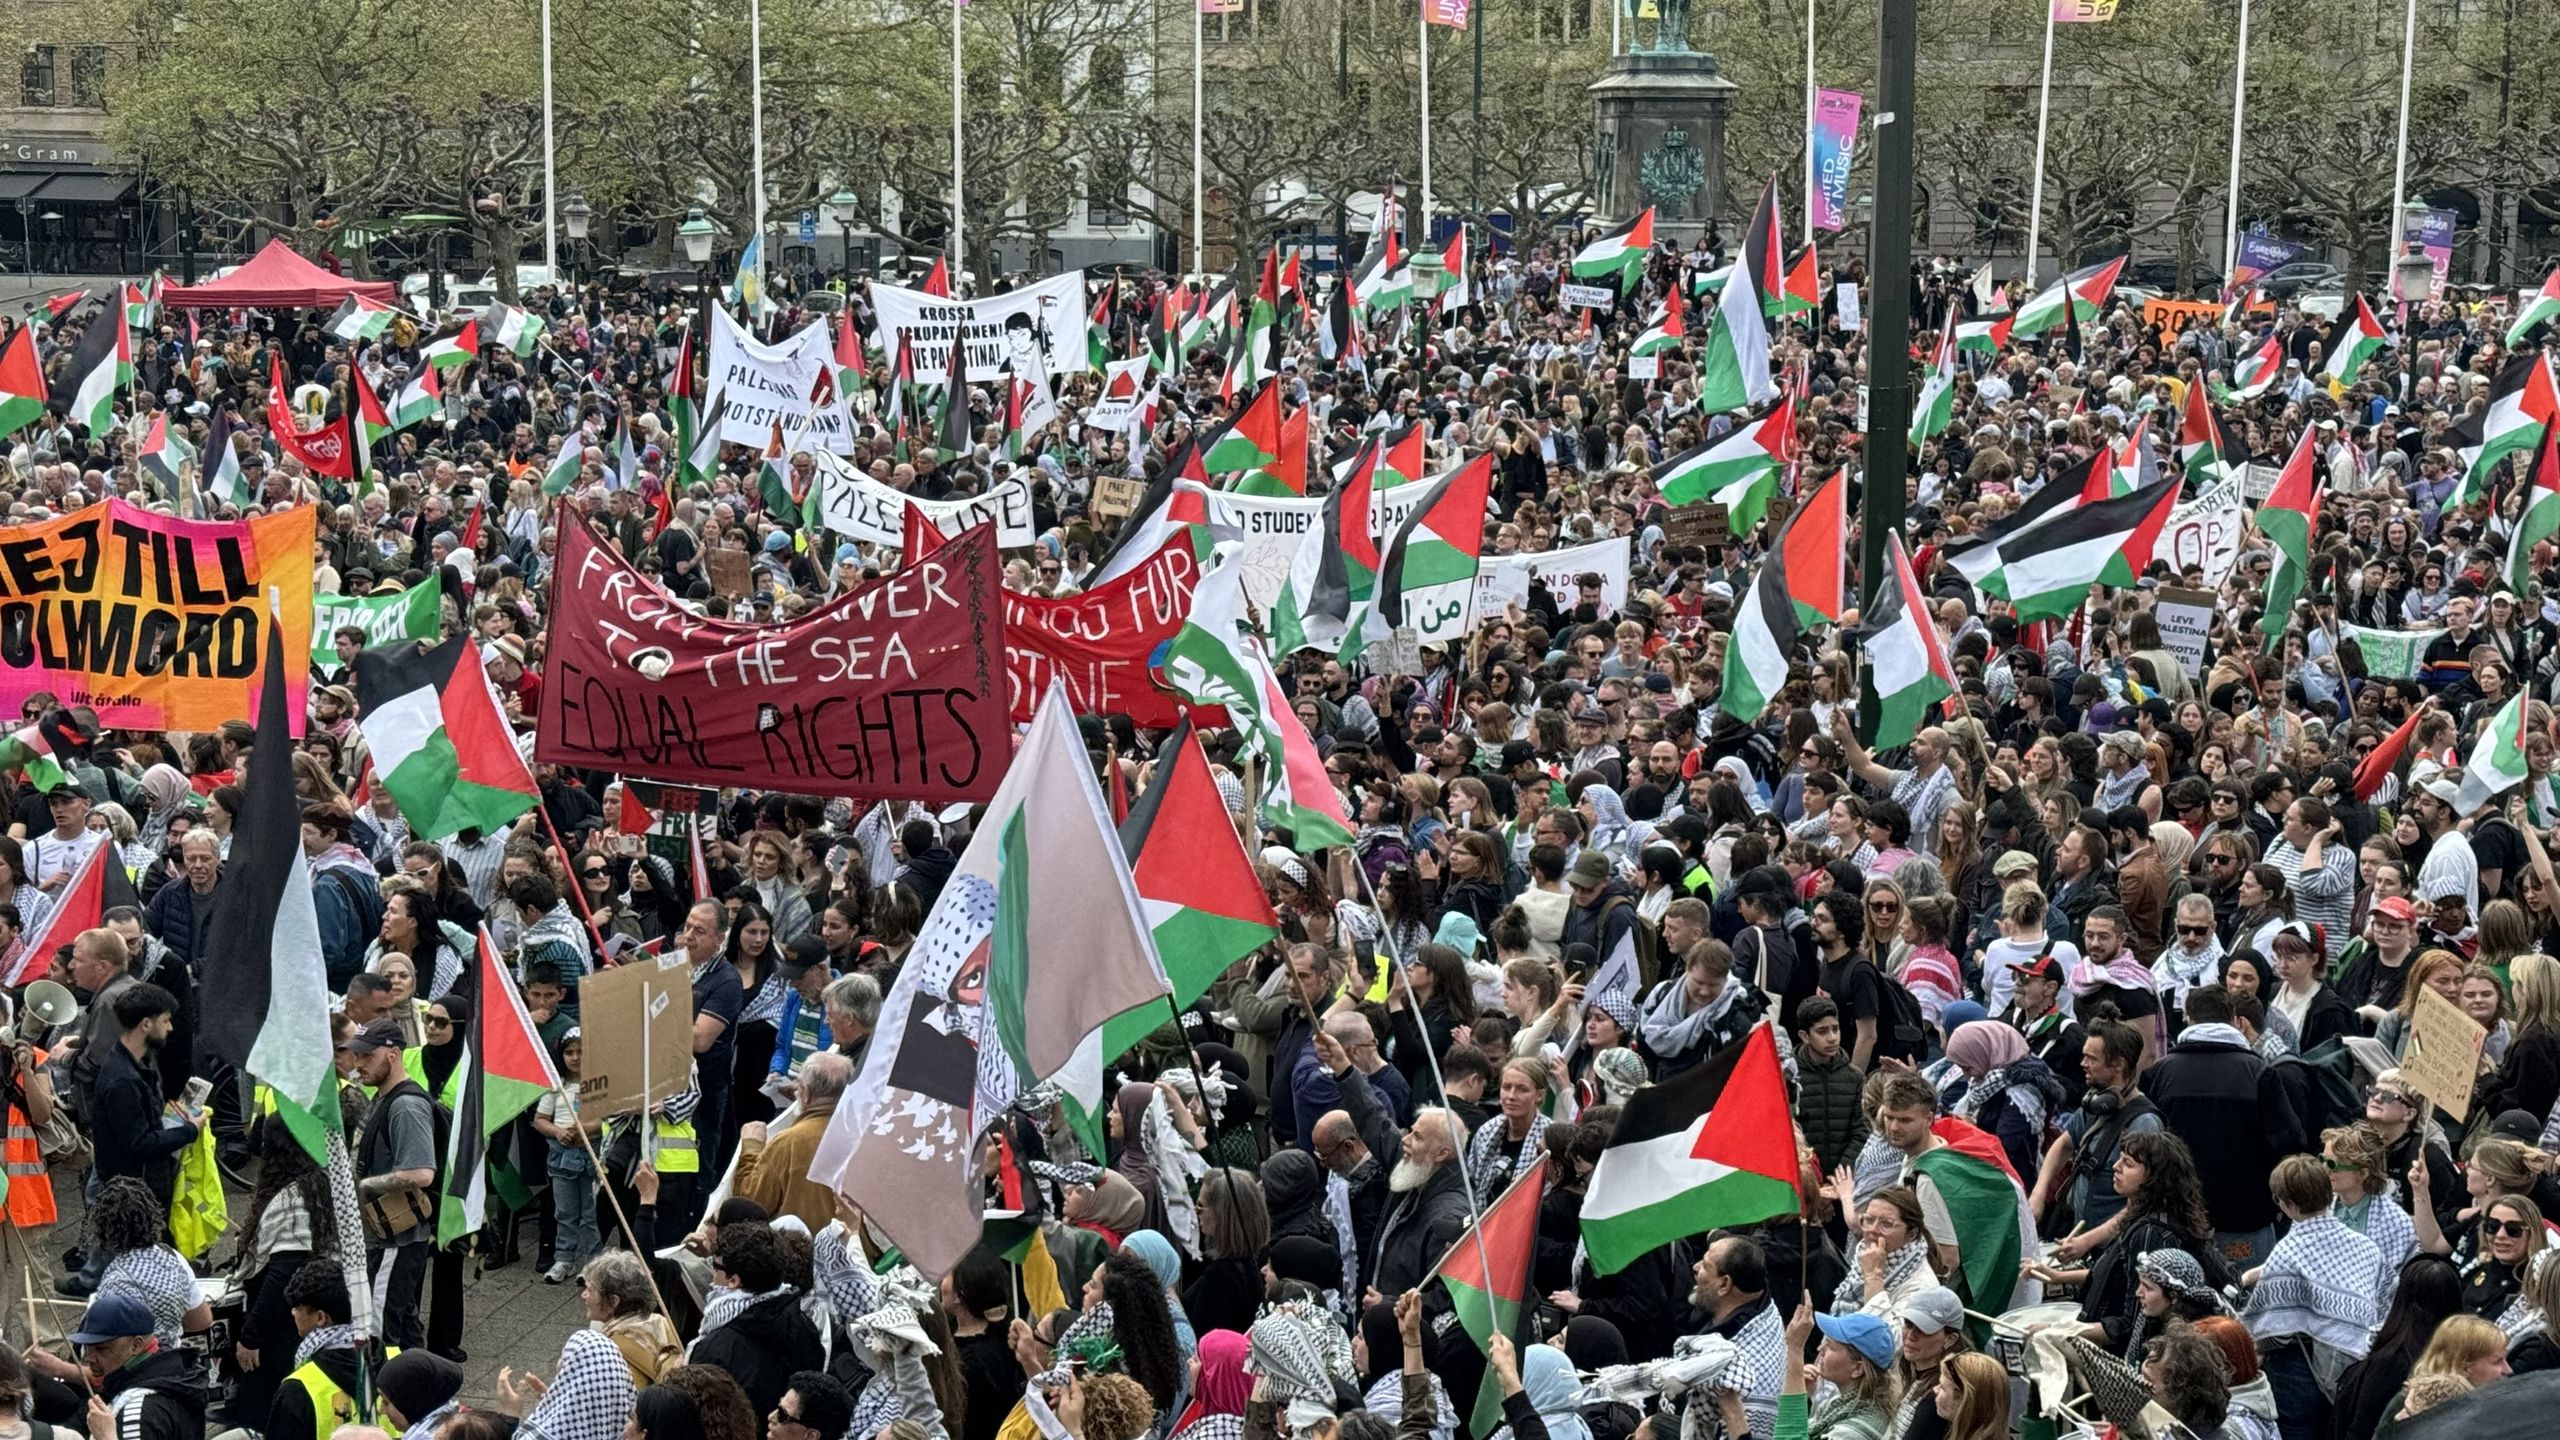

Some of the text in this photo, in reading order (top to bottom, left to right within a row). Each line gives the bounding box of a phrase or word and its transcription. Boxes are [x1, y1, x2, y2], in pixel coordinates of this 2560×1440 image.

[18, 145, 78, 160] Gram
[1832, 135, 1853, 198] MUSIC
[803, 212, 811, 225] P
[2430, 256, 2448, 308] USIC
[919, 306, 976, 321] KROSSA
[897, 323, 1003, 341] OCKUPATONEN!
[721, 400, 841, 434] MOTSTÅNDKAMP
[820, 468, 1029, 535] PALETINE
[113, 518, 260, 605] TILL
[1561, 569, 1610, 587] DÖA
[1421, 599, 1461, 634] من
[2171, 614, 2195, 626] LEVE
[599, 620, 673, 682] TO
[704, 640, 798, 688] THE
[2160, 643, 2201, 657] OKOTTA
[561, 661, 982, 789] EQUAL RIGHTS
